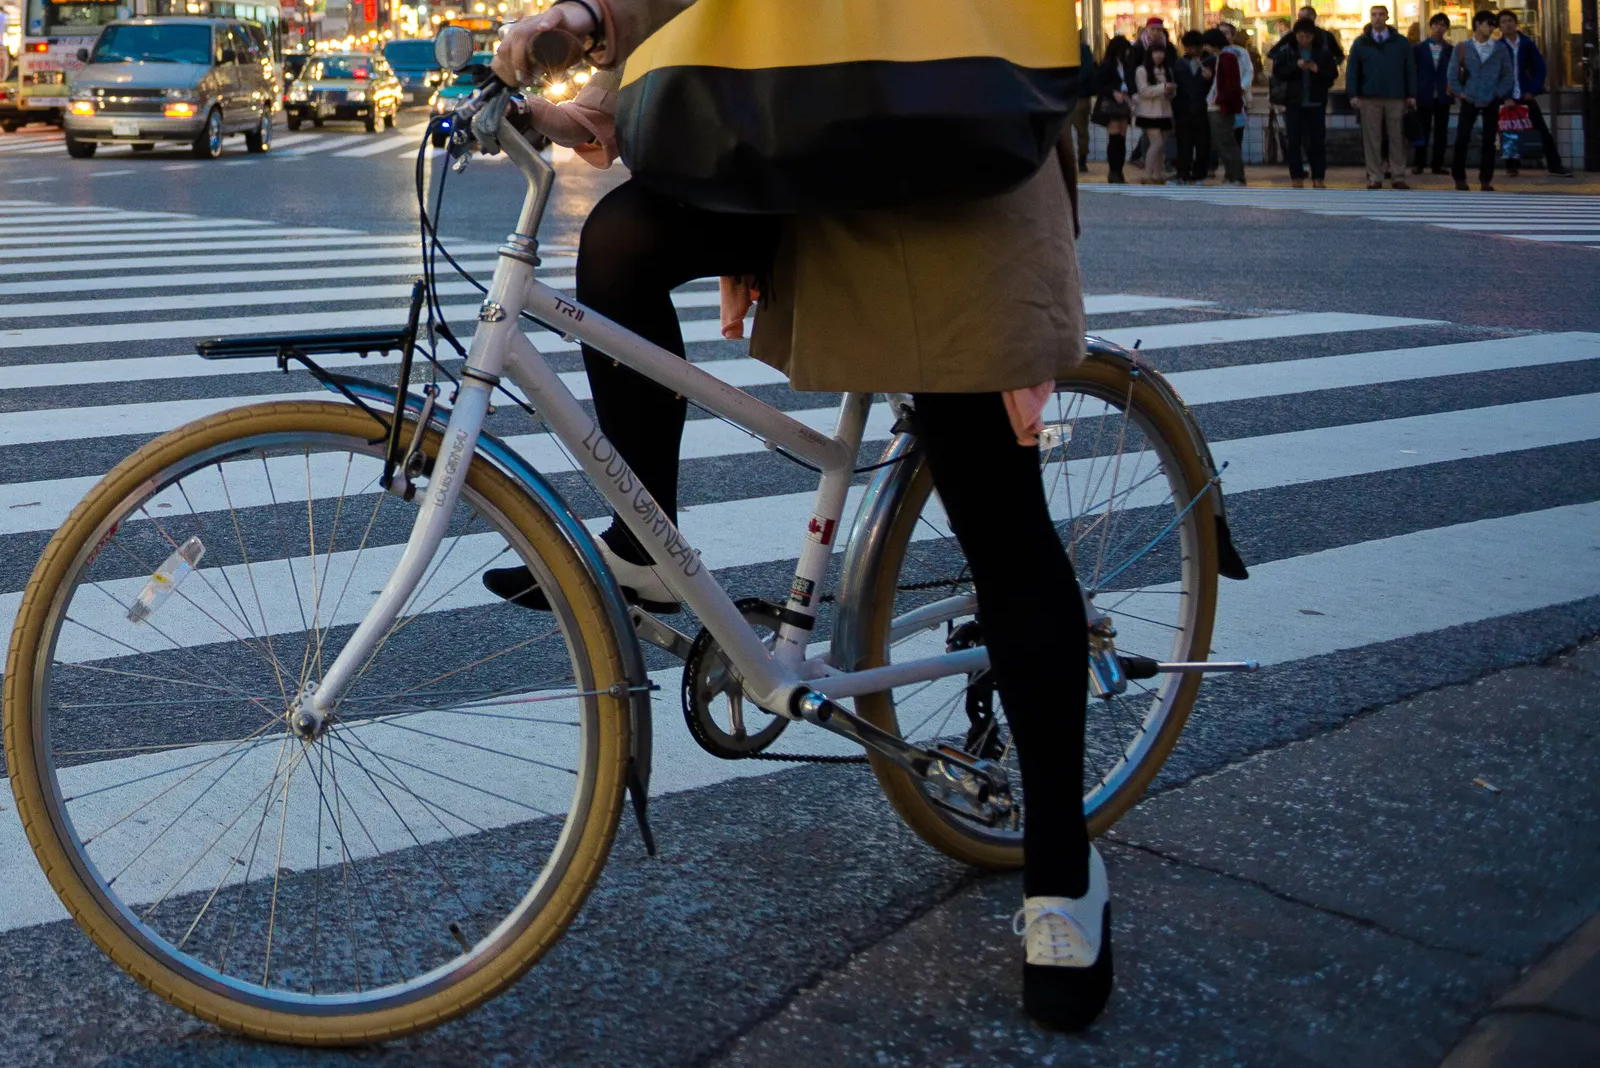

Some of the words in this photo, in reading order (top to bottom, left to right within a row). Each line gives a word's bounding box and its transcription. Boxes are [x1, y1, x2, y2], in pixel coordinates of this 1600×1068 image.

[432, 473, 453, 508] LOUIS
[582, 424, 636, 494] LOUIS
[632, 488, 701, 577] GARNEAU
